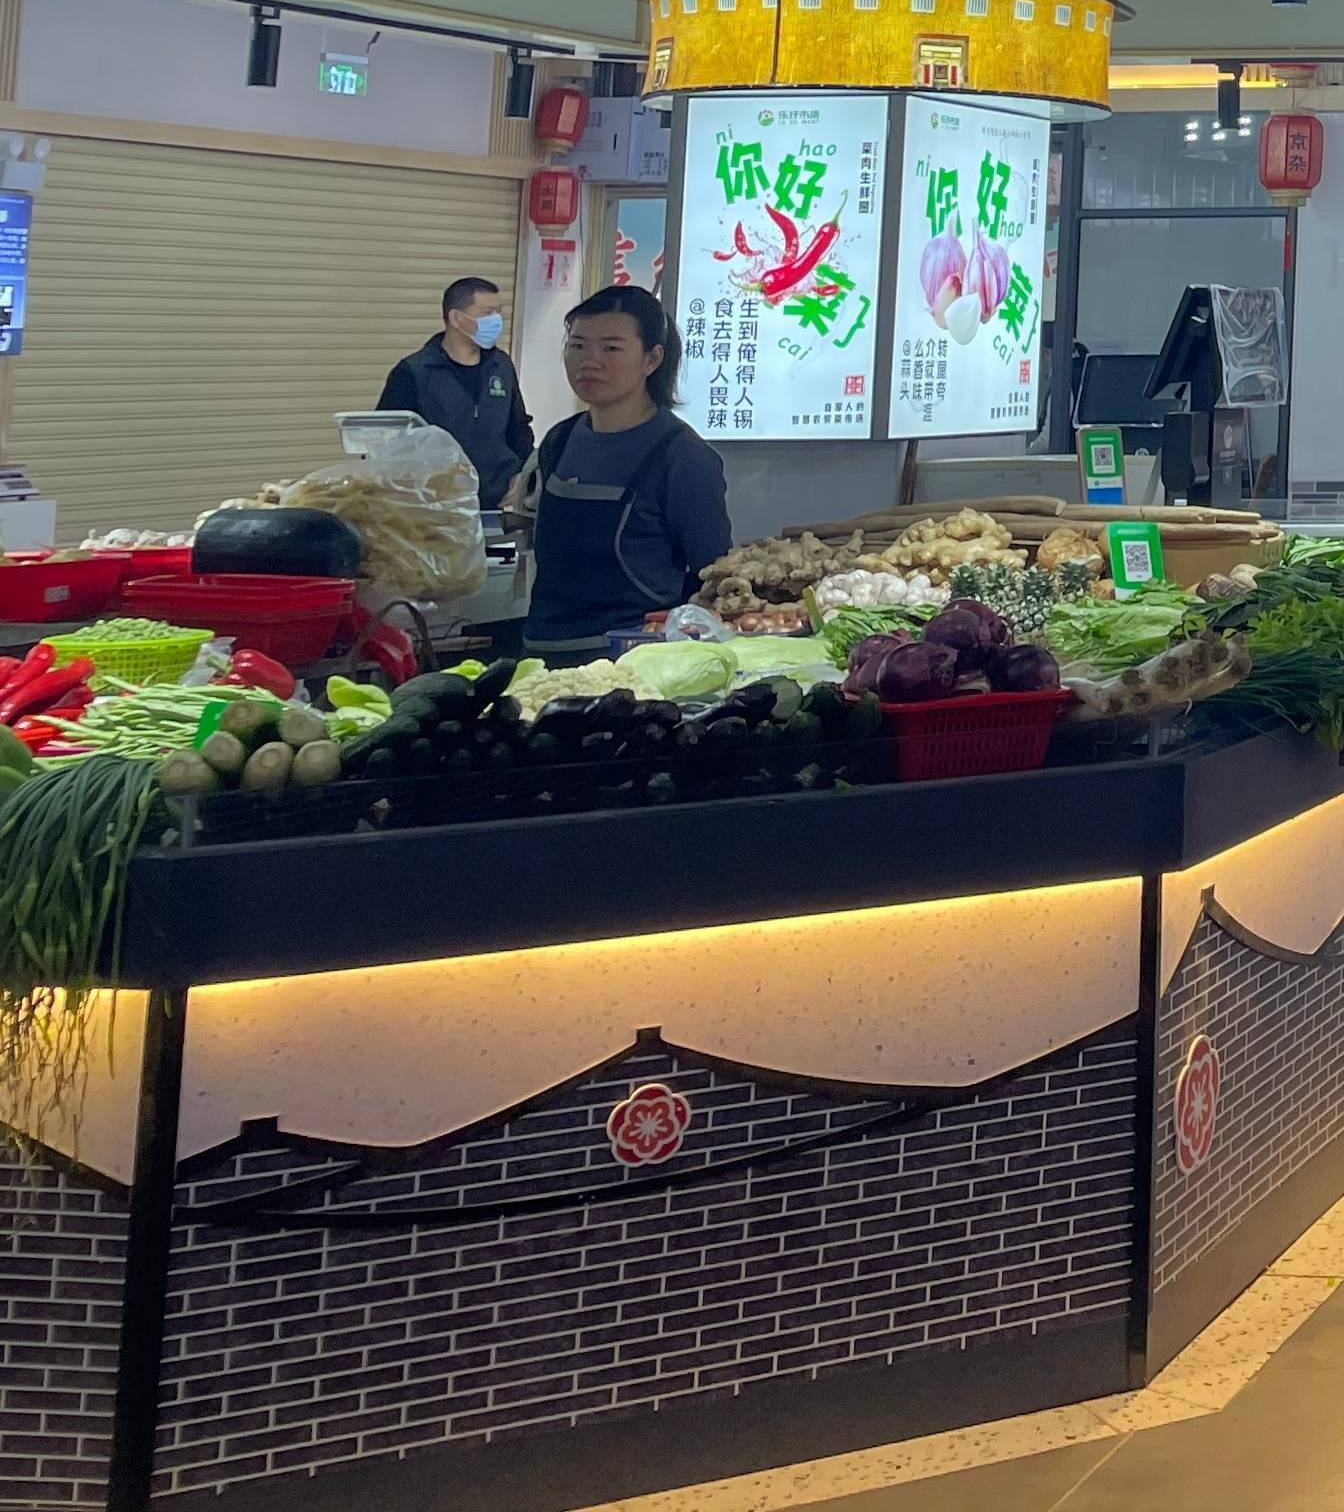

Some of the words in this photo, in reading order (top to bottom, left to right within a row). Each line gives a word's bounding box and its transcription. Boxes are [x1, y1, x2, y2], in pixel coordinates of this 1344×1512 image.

[715, 124, 733, 145] ni
[799, 139, 838, 157] hao
[714, 141, 828, 220] 你好
[916, 155, 931, 177] ni
[926, 149, 1012, 240] 你好
[1000, 213, 1024, 238] hao
[783, 263, 857, 338] 菜
[999, 262, 1033, 342] 菜
[684, 298, 706, 359] @辣椒
[778, 337, 812, 360] cai
[993, 335, 1014, 365] cai
[707, 298, 734, 429] 食去得人畏辣
